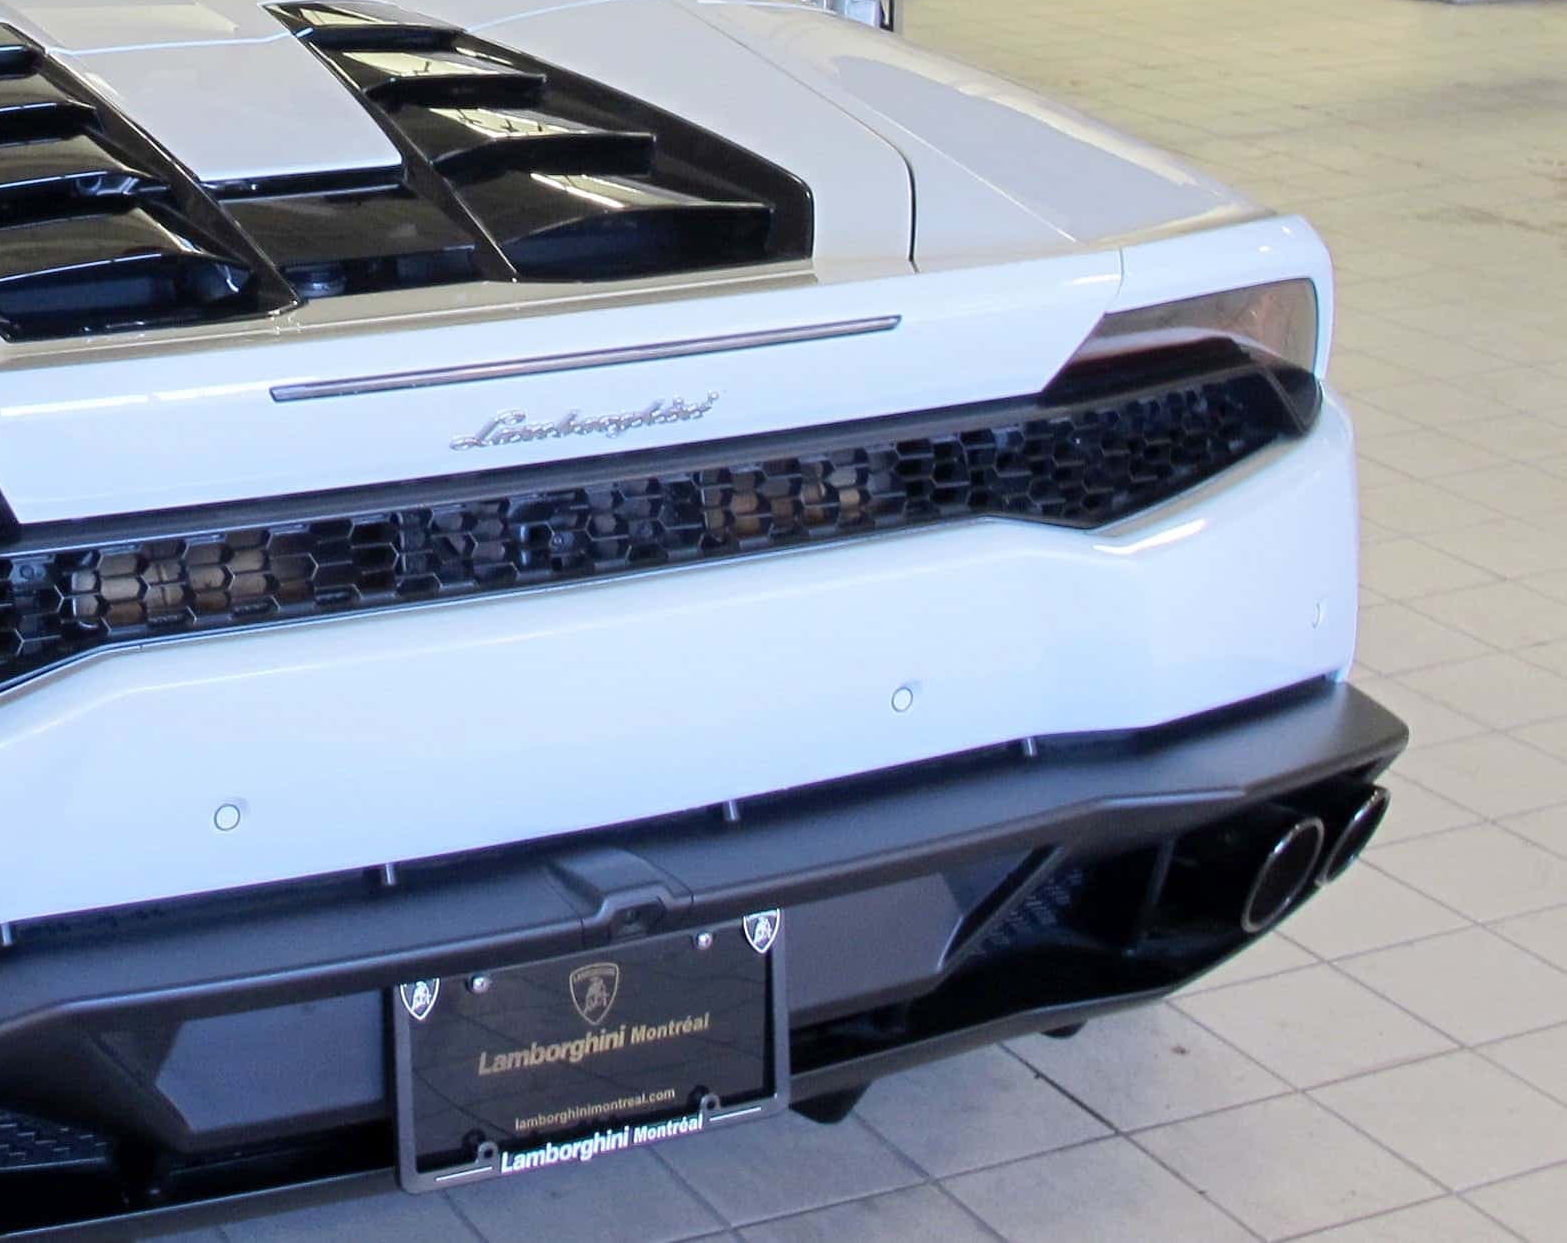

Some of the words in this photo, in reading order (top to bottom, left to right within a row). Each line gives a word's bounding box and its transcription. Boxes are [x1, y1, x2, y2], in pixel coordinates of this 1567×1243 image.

[478, 1025, 625, 1076] Lamborghini
[630, 1013, 710, 1044] Montréal
[515, 1088, 676, 1131] lamborghinimontreal.com
[500, 1126, 630, 1174] Lamborghini
[633, 1114, 704, 1144] Montréal
